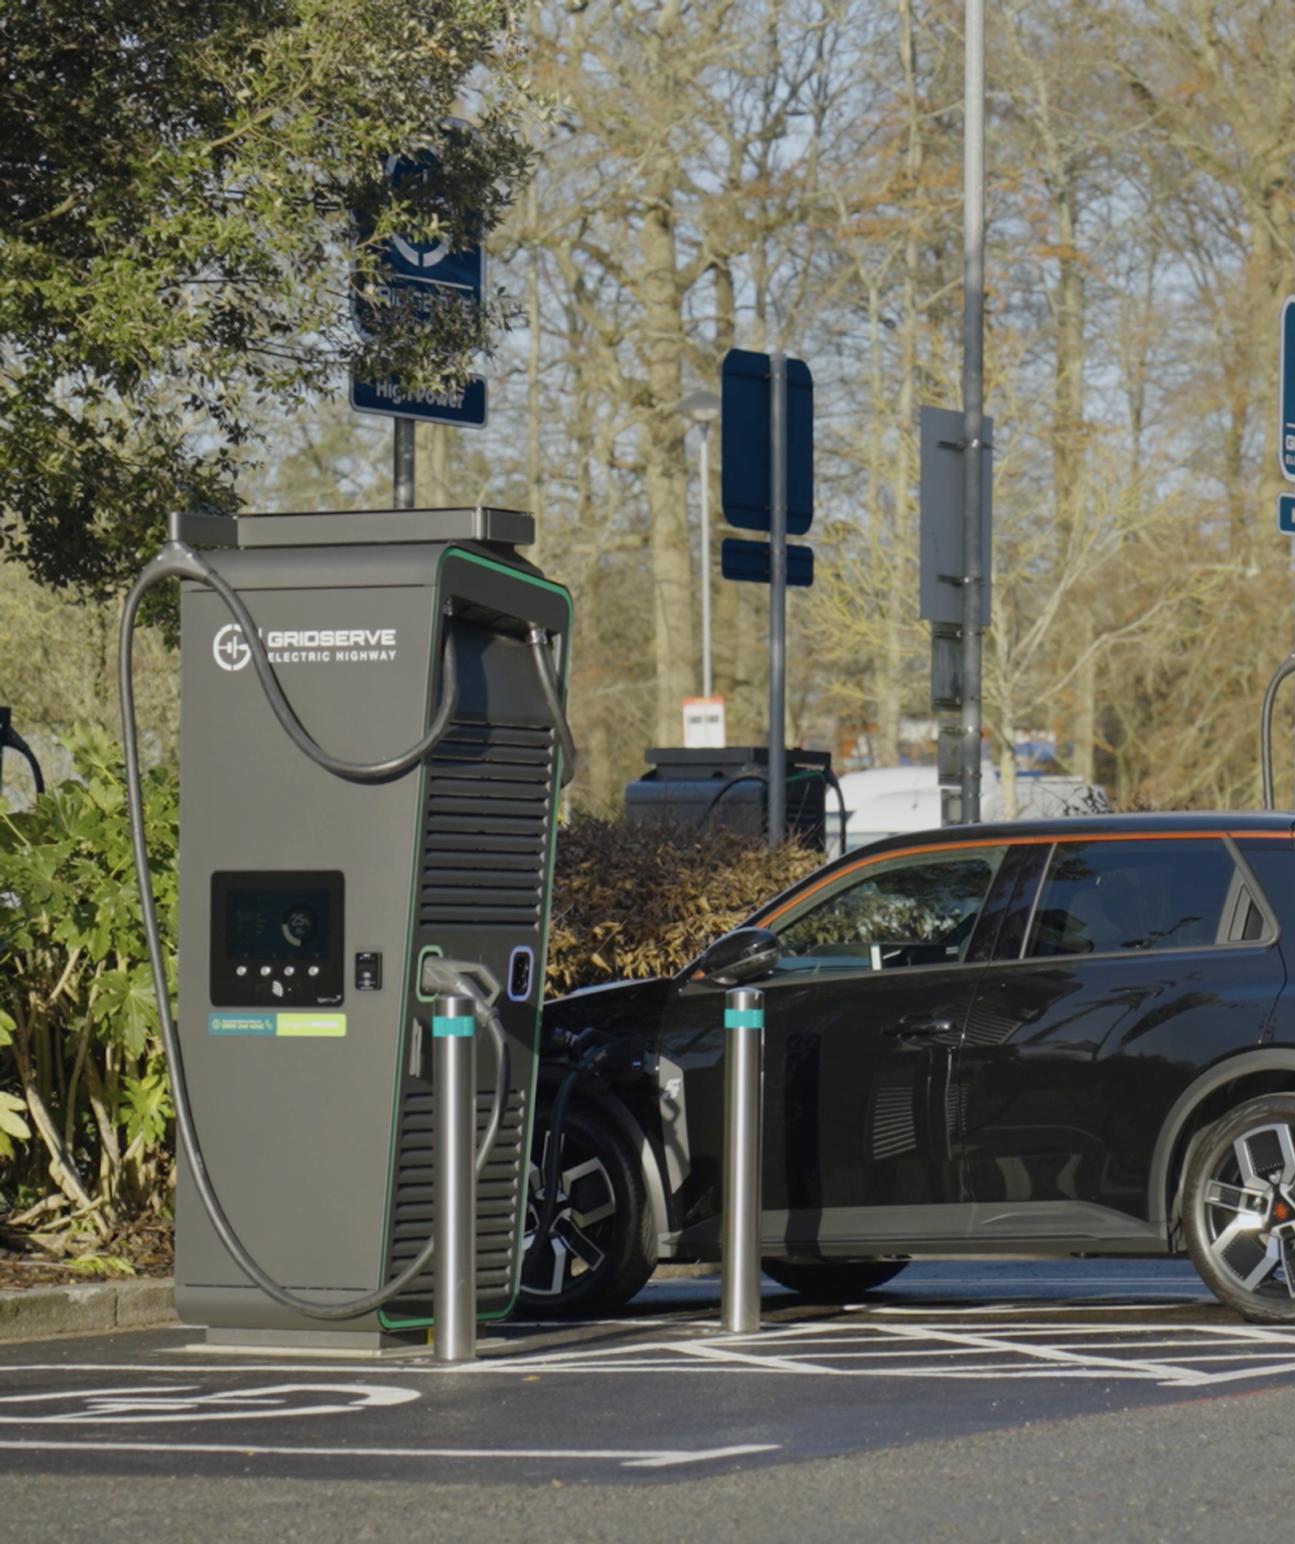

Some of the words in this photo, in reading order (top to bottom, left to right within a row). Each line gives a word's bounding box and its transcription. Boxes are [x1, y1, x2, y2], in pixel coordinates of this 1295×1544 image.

[268, 629, 396, 647] GRIDSERVE
[267, 651, 330, 663] ELECTRIC
[336, 650, 396, 661] HIGHWAY
